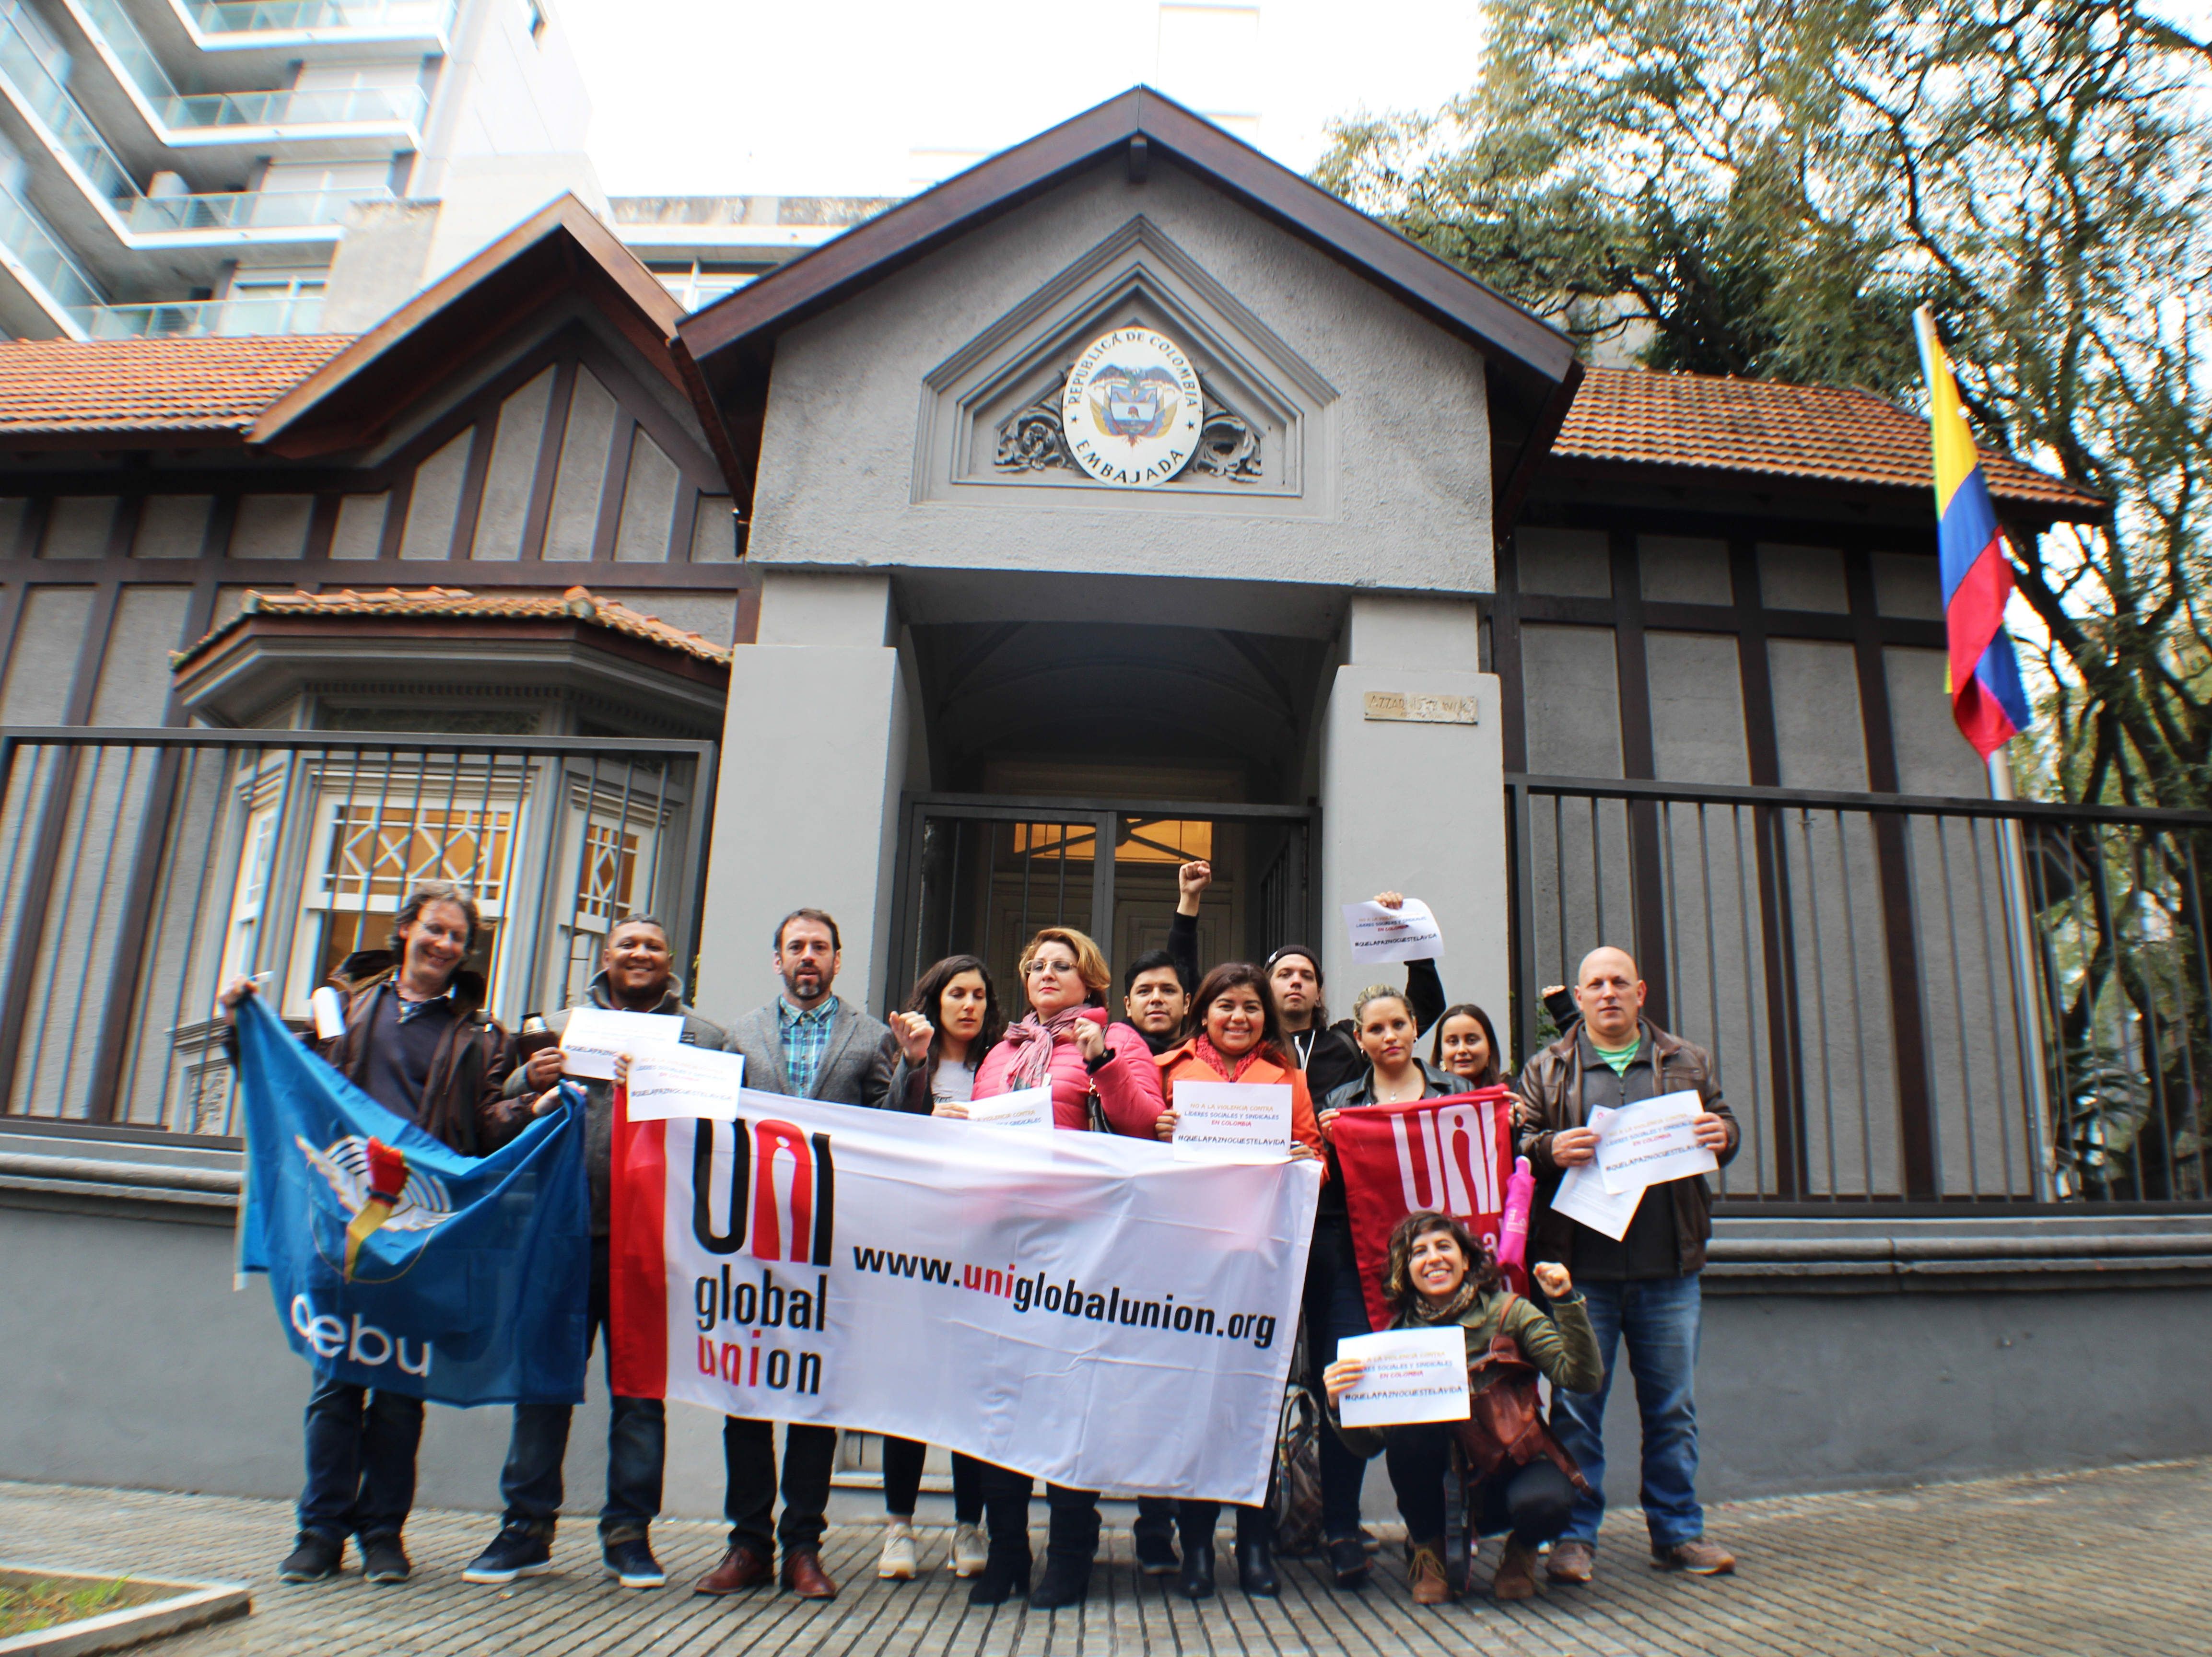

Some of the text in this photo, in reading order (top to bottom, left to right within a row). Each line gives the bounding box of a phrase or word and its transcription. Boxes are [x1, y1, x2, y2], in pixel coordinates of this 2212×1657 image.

[1068, 331, 1198, 407] REPUBLICA DE COLOMBIA
[1076, 439, 1184, 483] EMBAJADA
[1178, 1134, 1286, 1146] #QUELAPAZNOCUESTELAVIDA
[695, 1263, 828, 1332] global
[853, 1246, 1276, 1349] www.uniglobalunion.org
[697, 1330, 822, 1395] union
[1378, 1363, 1408, 1371] SOCIALES
[1391, 1370, 1424, 1378] COLOMBIA
